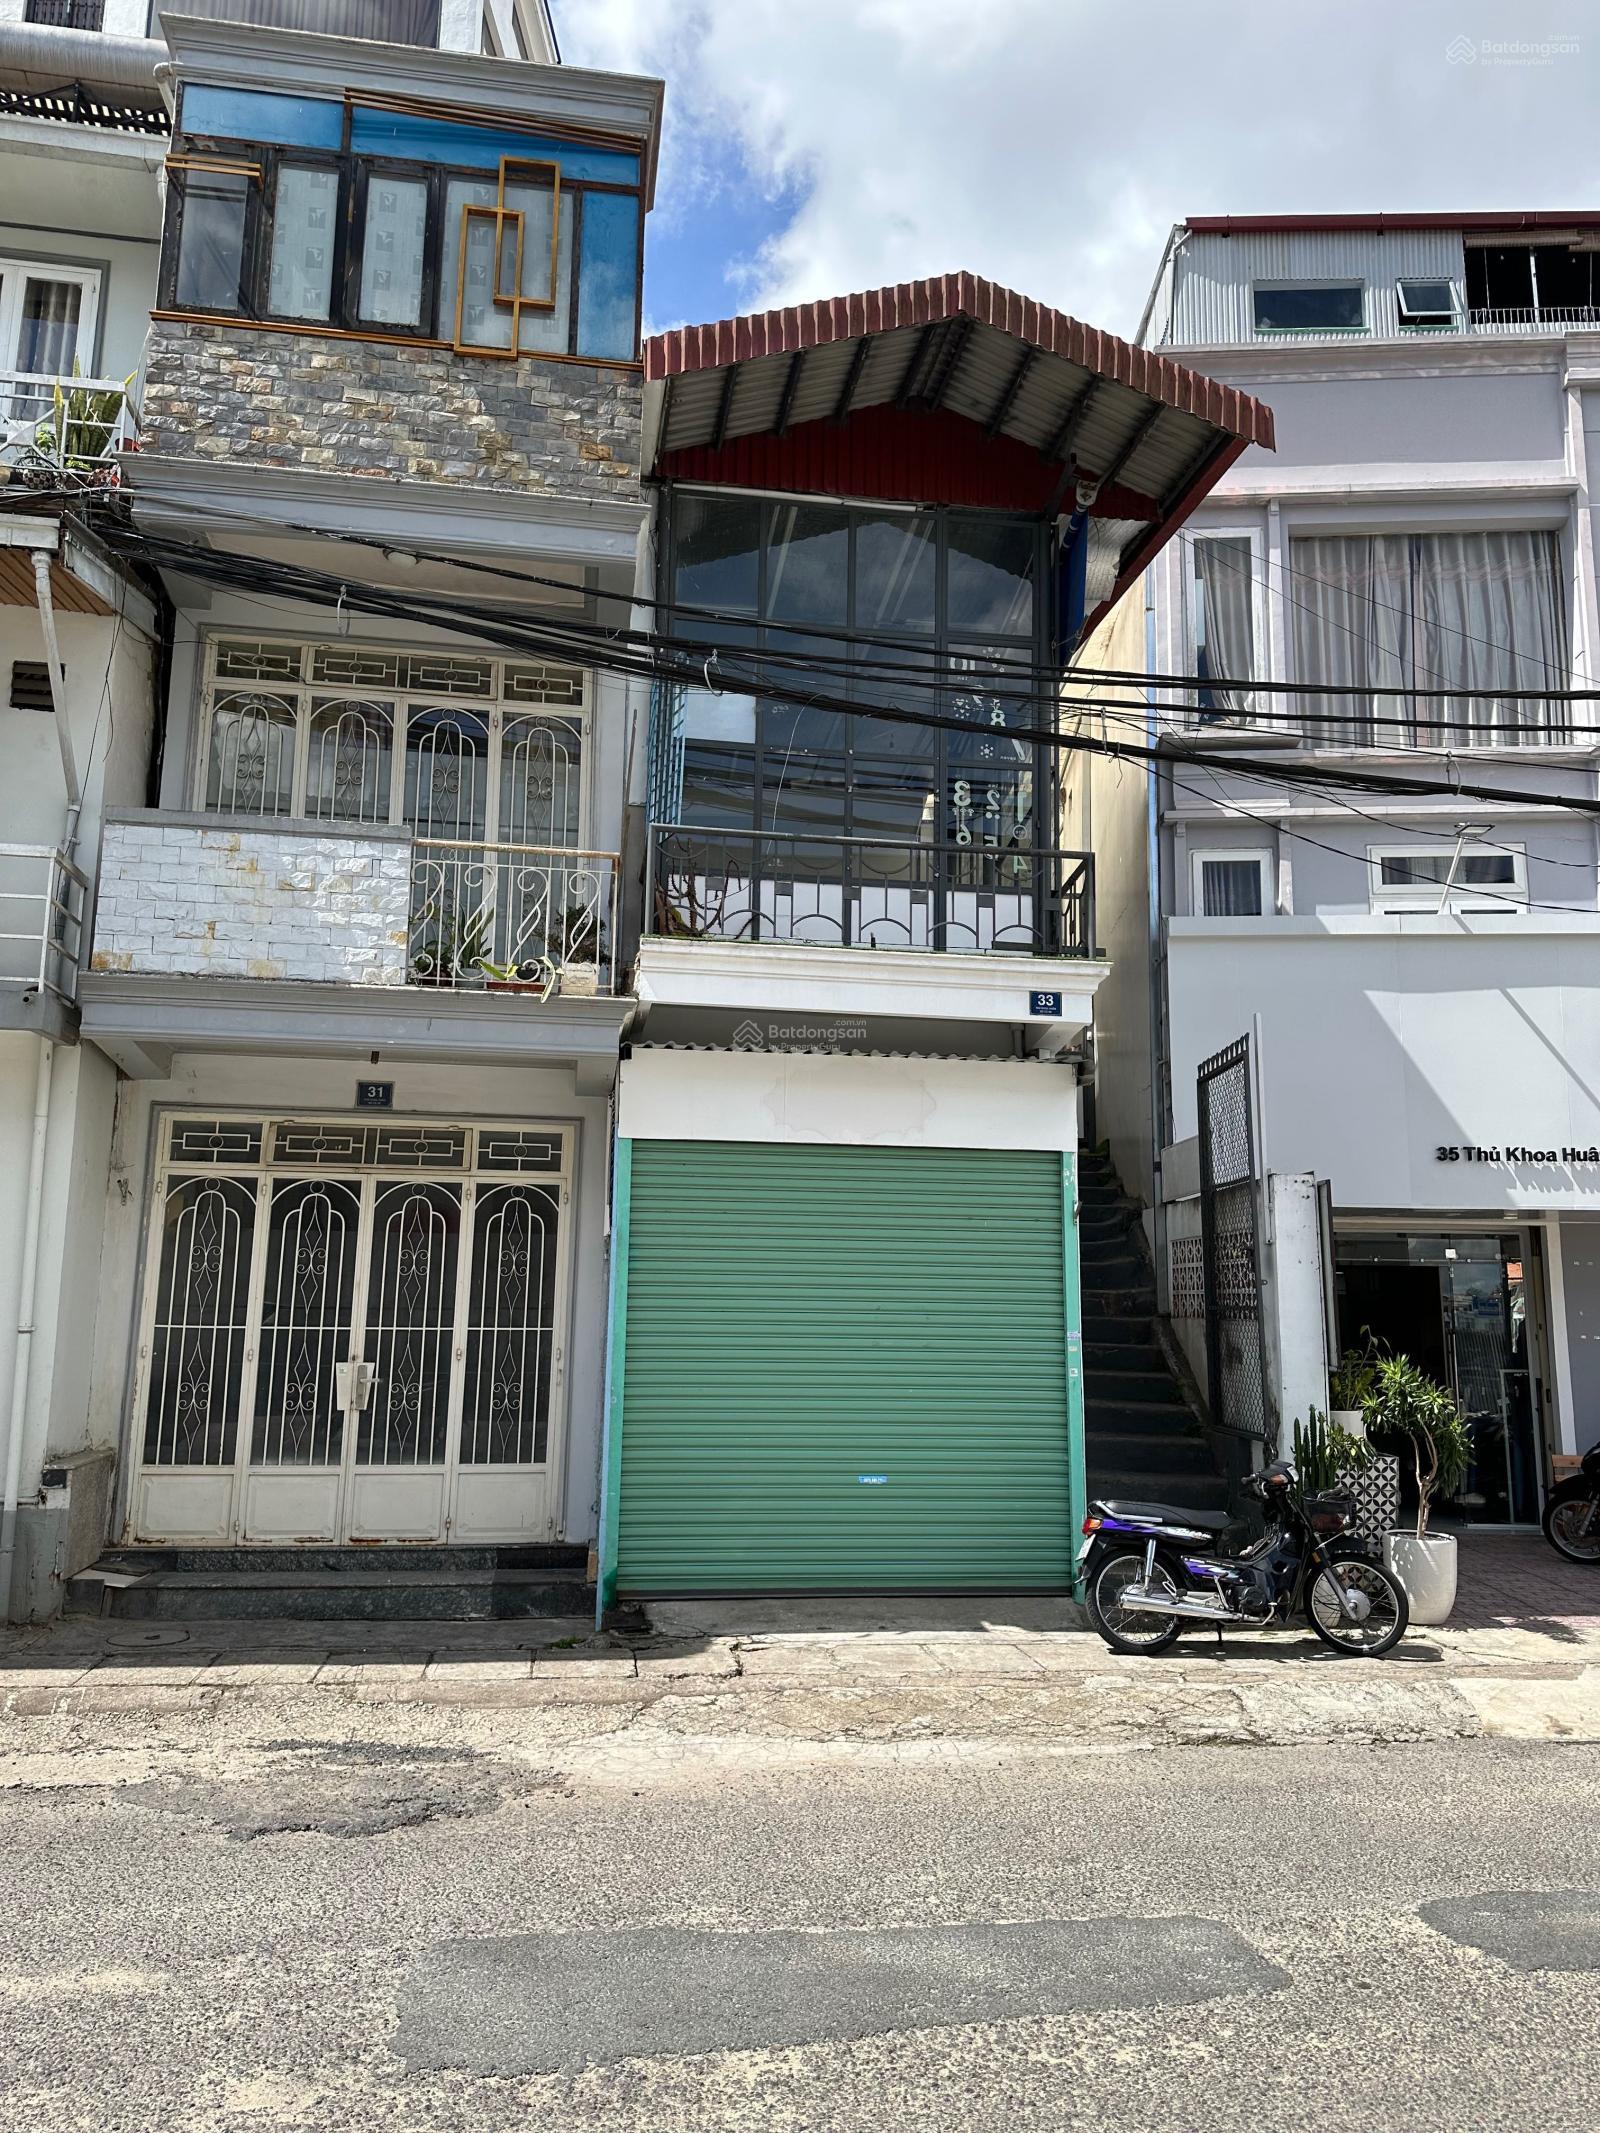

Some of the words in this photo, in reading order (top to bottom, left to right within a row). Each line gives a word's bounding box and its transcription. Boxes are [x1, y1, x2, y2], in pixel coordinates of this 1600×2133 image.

[1037, 994, 1054, 1006] 33
[367, 1086, 383, 1098] 31
[1436, 1147, 1460, 1162] 35
[1463, 1146, 1501, 1162] Thủ
[1506, 1147, 1557, 1162] Khoa
